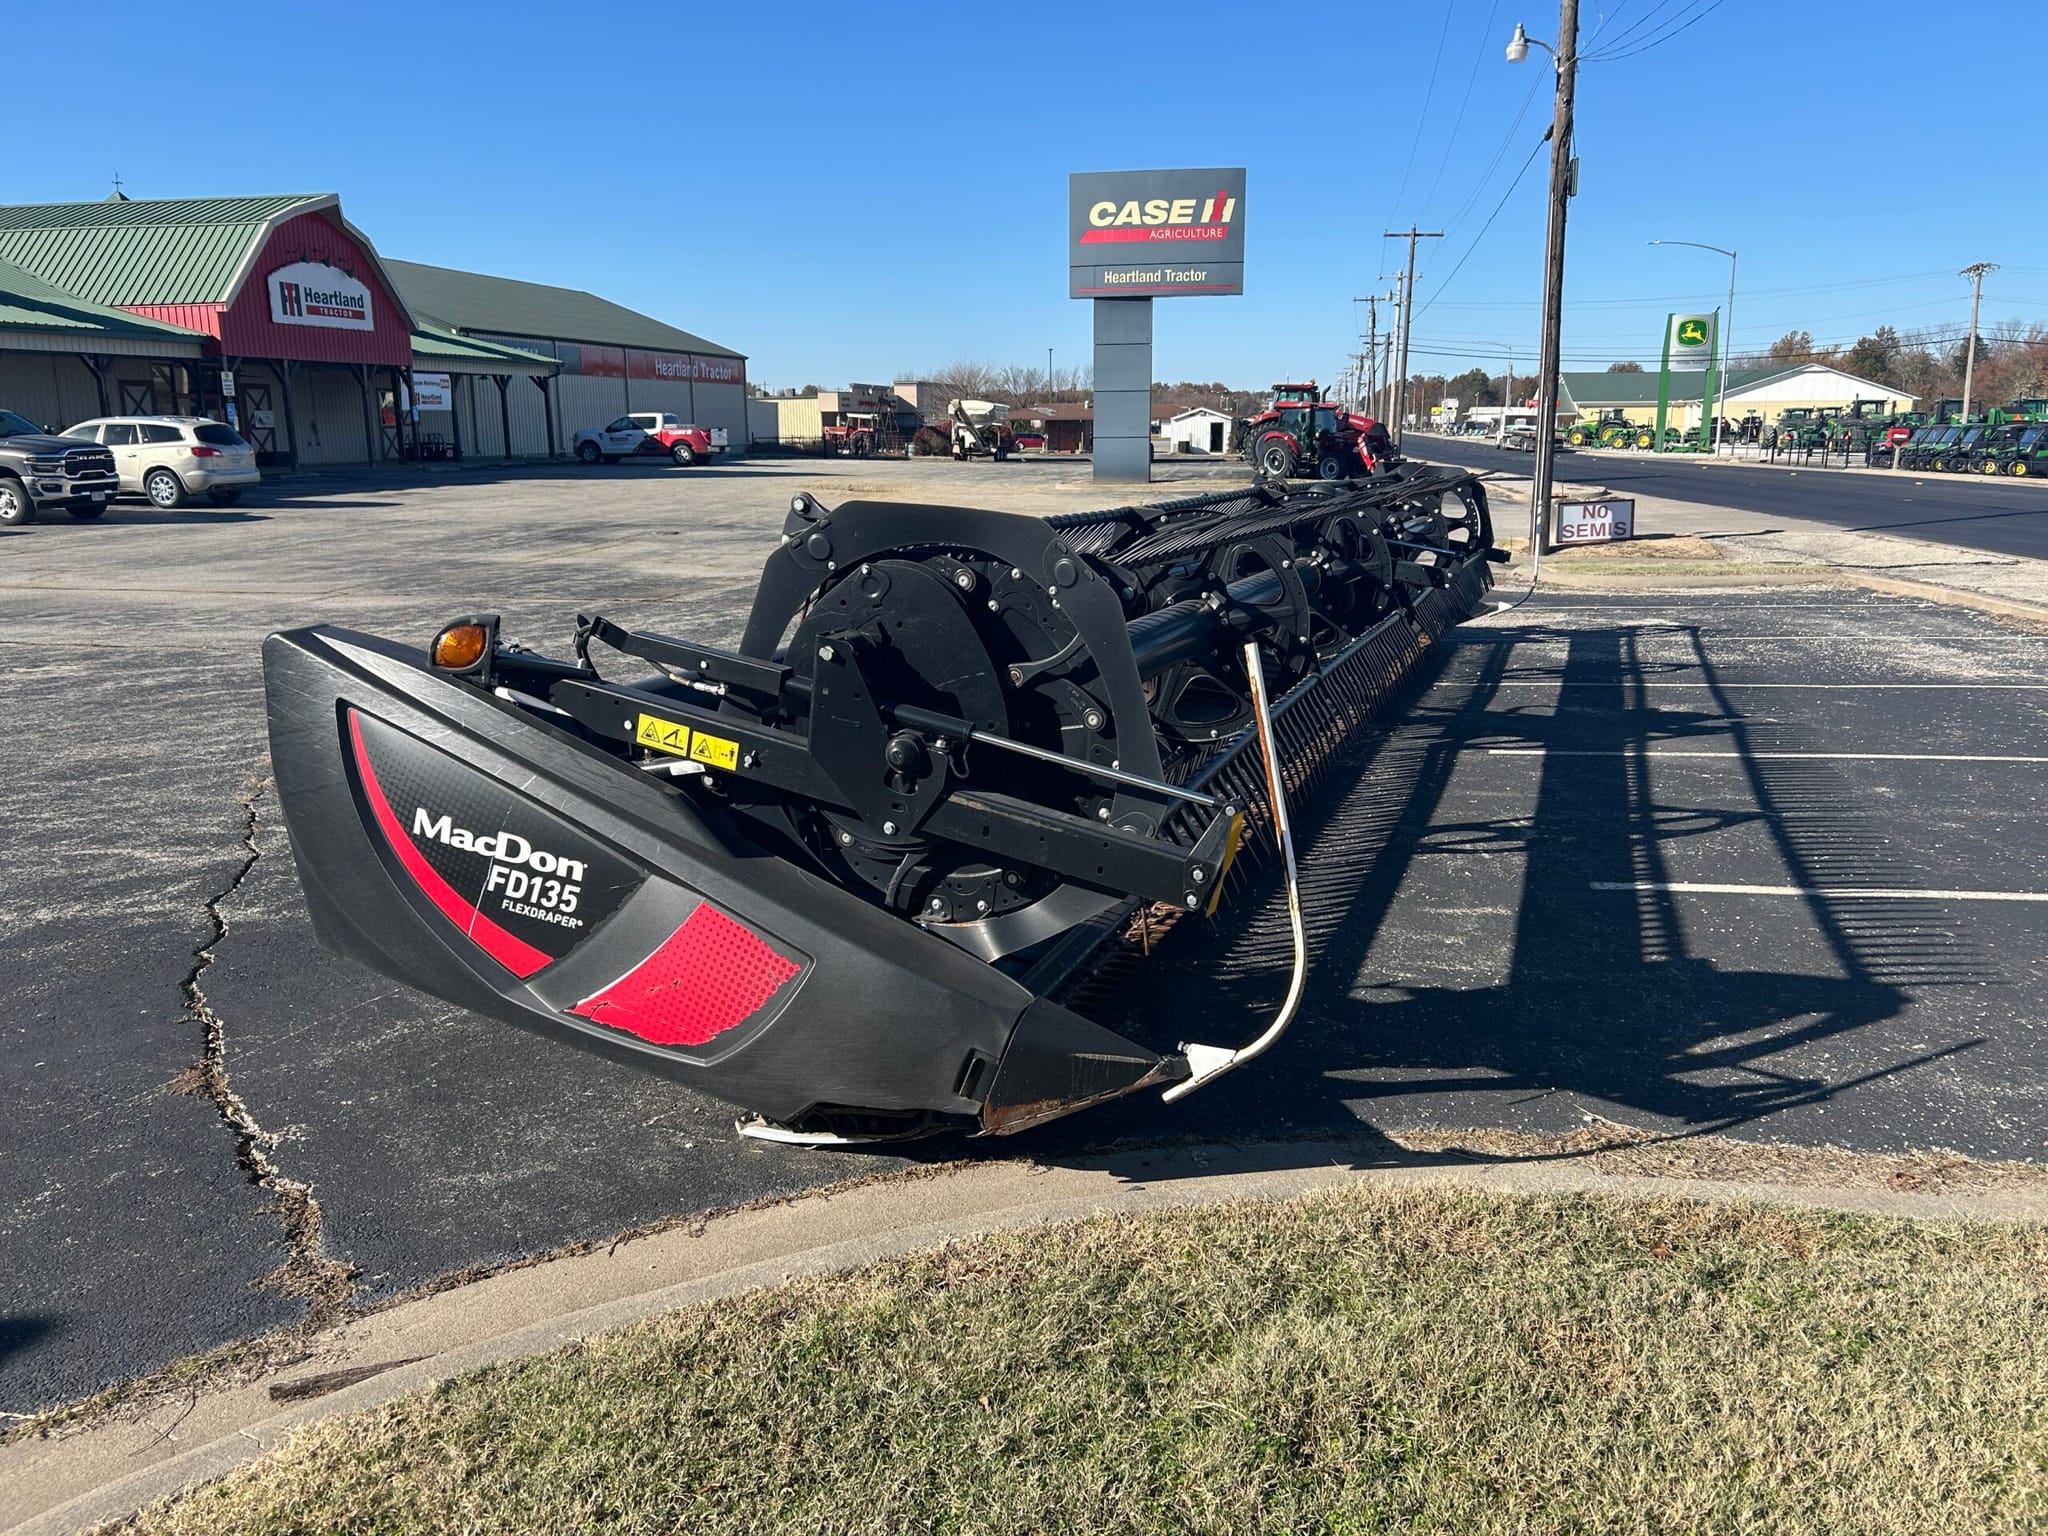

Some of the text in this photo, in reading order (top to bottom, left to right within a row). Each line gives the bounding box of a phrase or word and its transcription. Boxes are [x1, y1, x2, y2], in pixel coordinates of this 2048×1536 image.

[1089, 199, 1197, 227] CASE
[1149, 228, 1223, 240] AGRICULTURE
[1104, 269, 1207, 284] Heartland Tractor
[303, 286, 365, 309] Heartland
[319, 307, 353, 318] TRACTOR
[700, 362, 733, 380] Tractor
[1582, 505, 1609, 519] NO
[1562, 521, 1627, 538] SEMIS
[412, 807, 586, 881] MacDon
[487, 864, 581, 913] FD135
